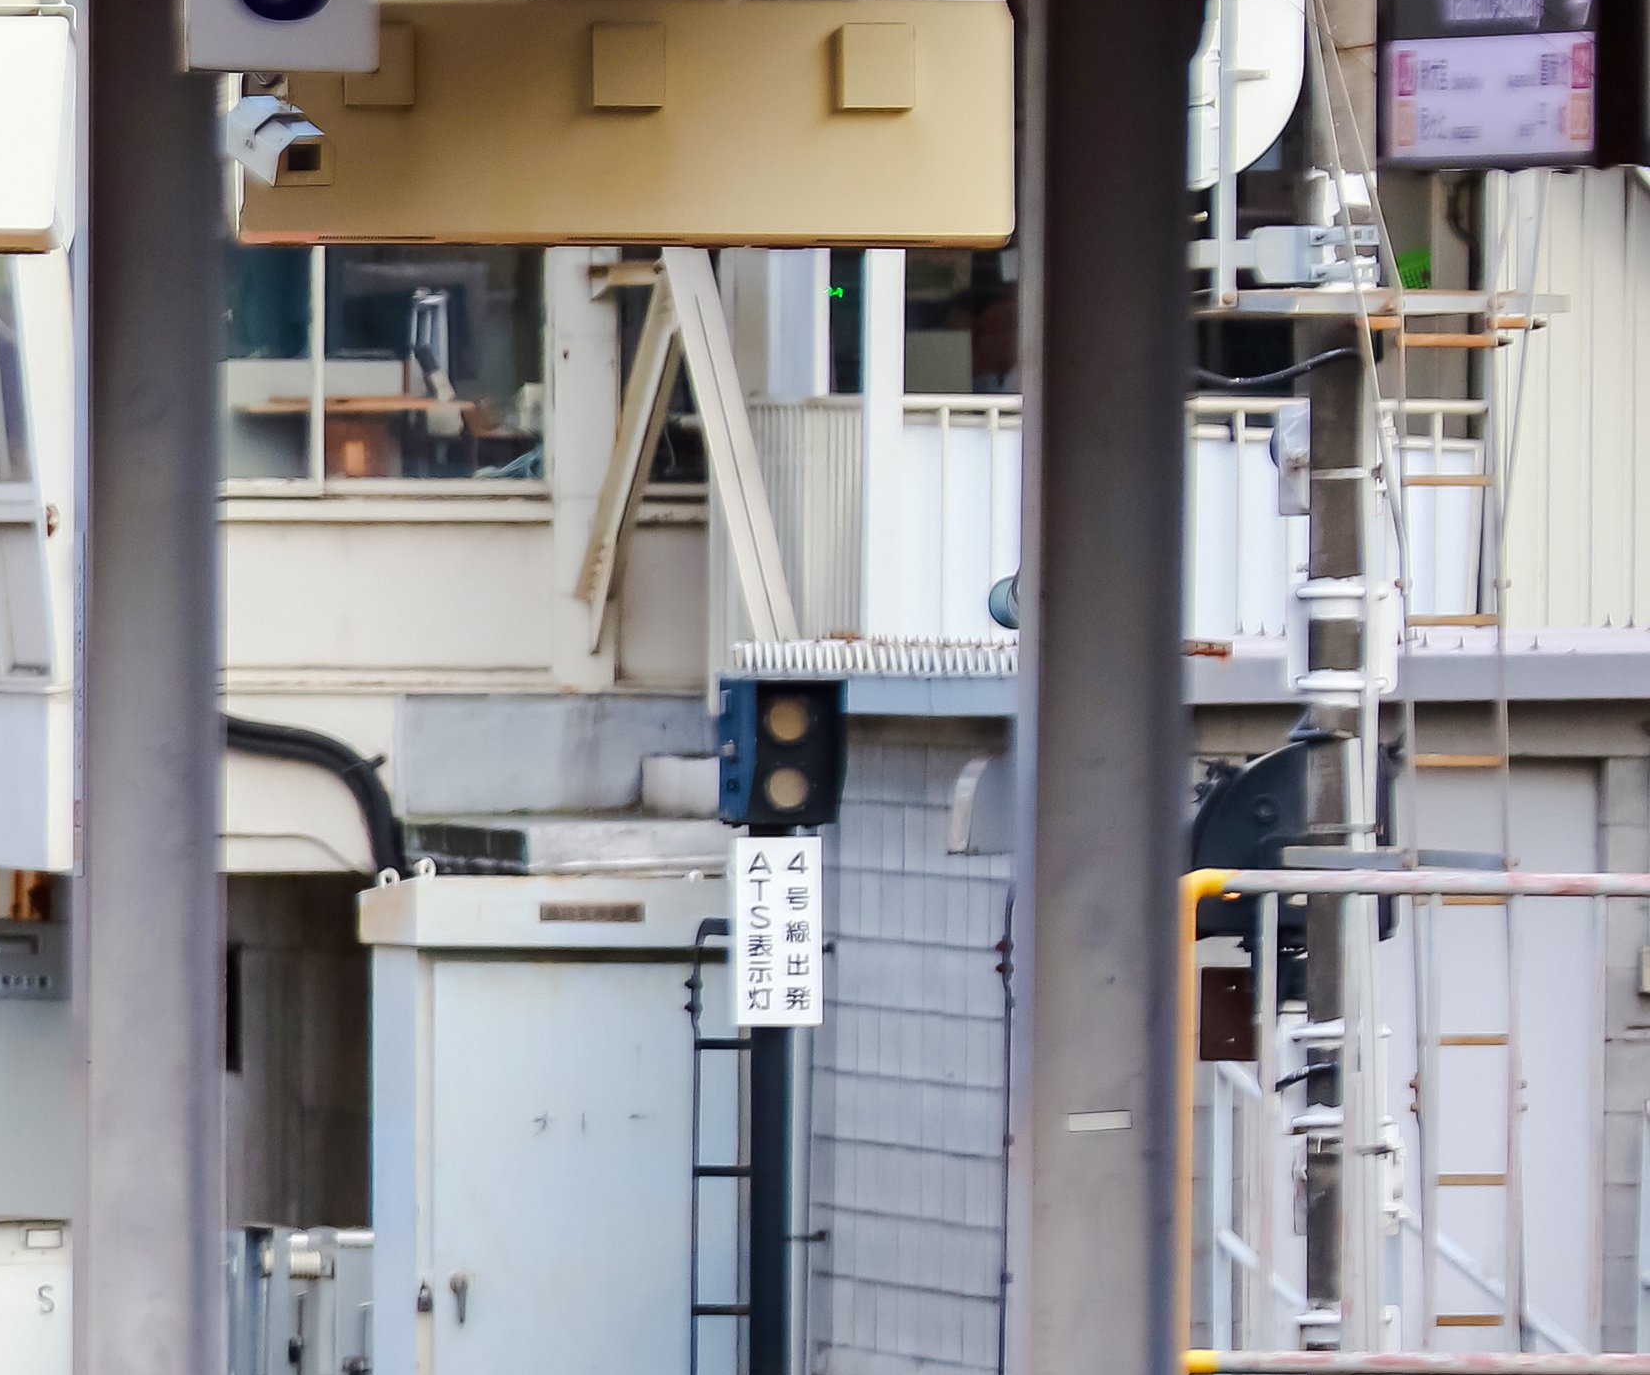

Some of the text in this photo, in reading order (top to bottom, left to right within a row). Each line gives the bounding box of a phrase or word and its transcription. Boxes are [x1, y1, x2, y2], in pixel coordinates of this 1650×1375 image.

[748, 850, 773, 1011] ATS表示灯
[786, 850, 811, 1011] 4号線出発
